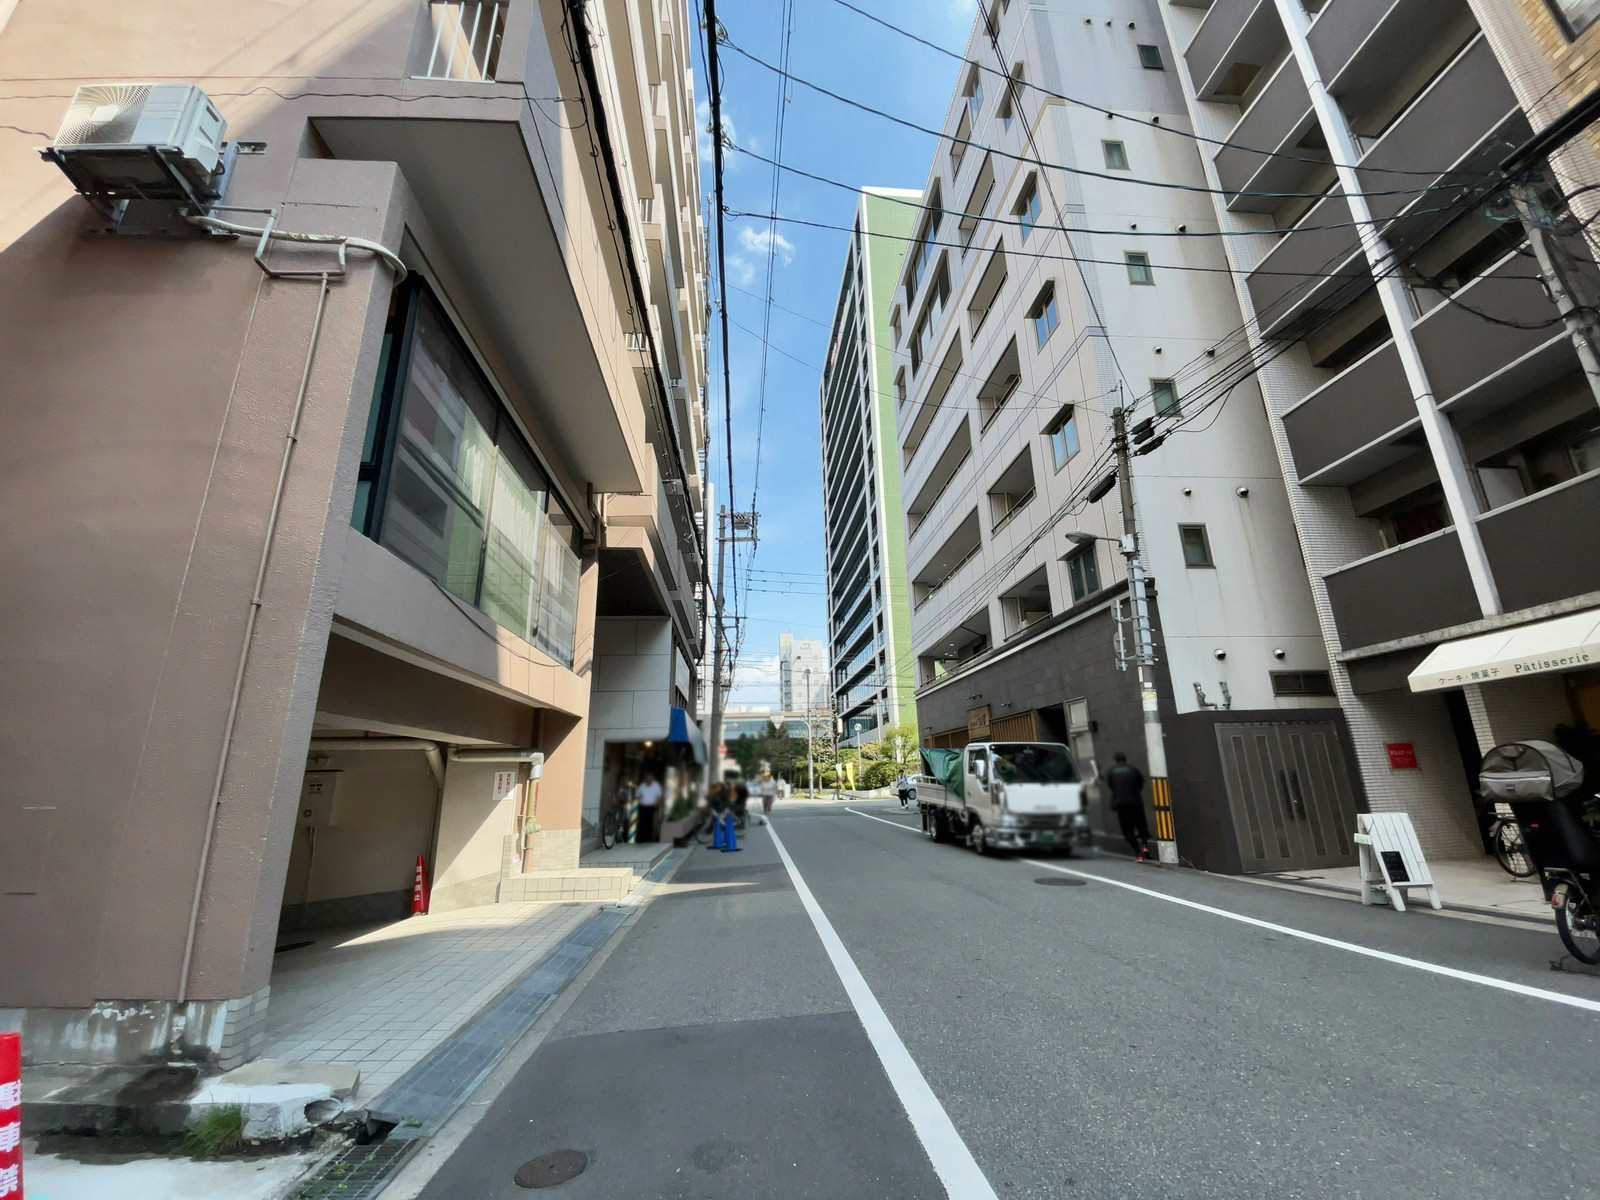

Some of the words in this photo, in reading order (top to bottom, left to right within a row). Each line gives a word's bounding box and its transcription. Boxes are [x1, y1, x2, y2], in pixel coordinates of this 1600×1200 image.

[1438, 667, 1500, 684] ケーキ・焼菓子
[1514, 653, 1591, 673] Pâtisserie
